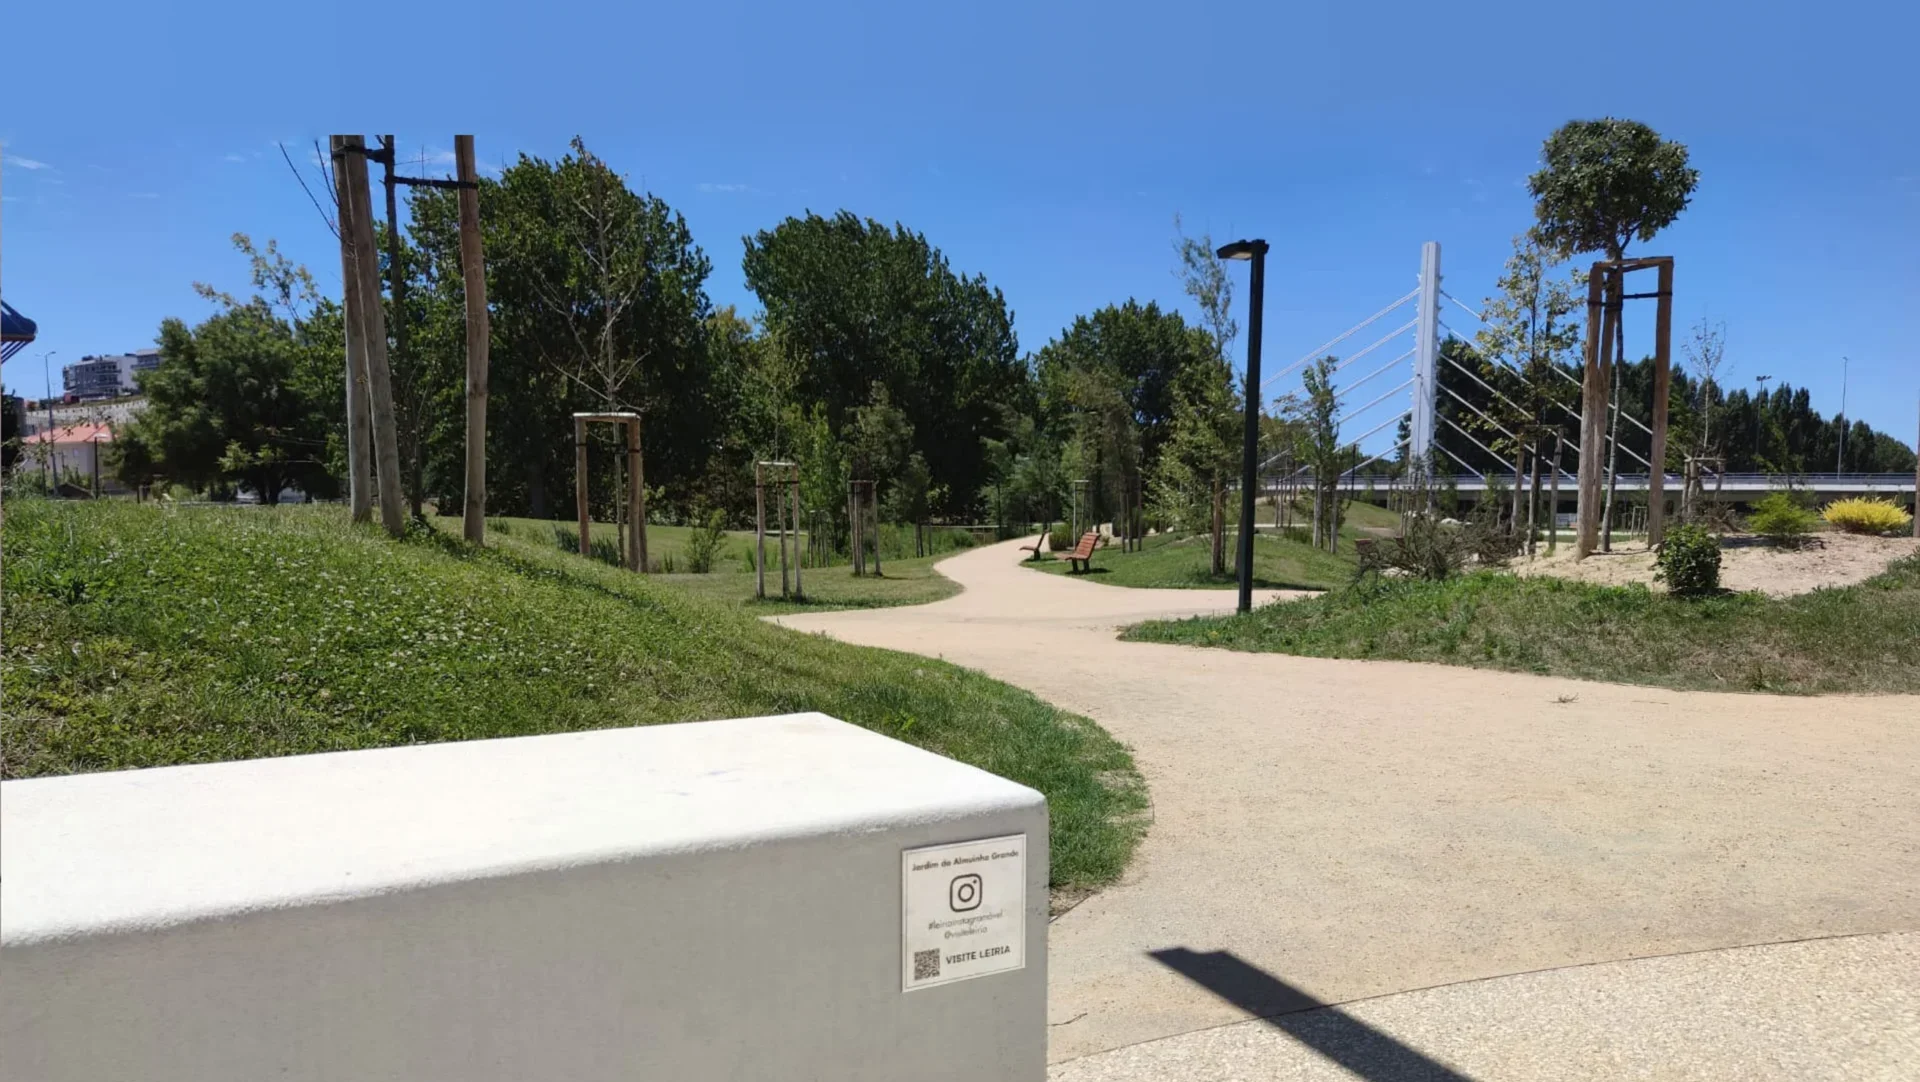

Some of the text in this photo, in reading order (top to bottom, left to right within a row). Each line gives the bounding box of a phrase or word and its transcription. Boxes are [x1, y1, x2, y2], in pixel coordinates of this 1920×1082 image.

[912, 860, 939, 871] Jardim
[954, 855, 989, 865] Almuinha
[992, 850, 1019, 860] Grande
[946, 945, 1011, 965] VISITE LEIRIA
